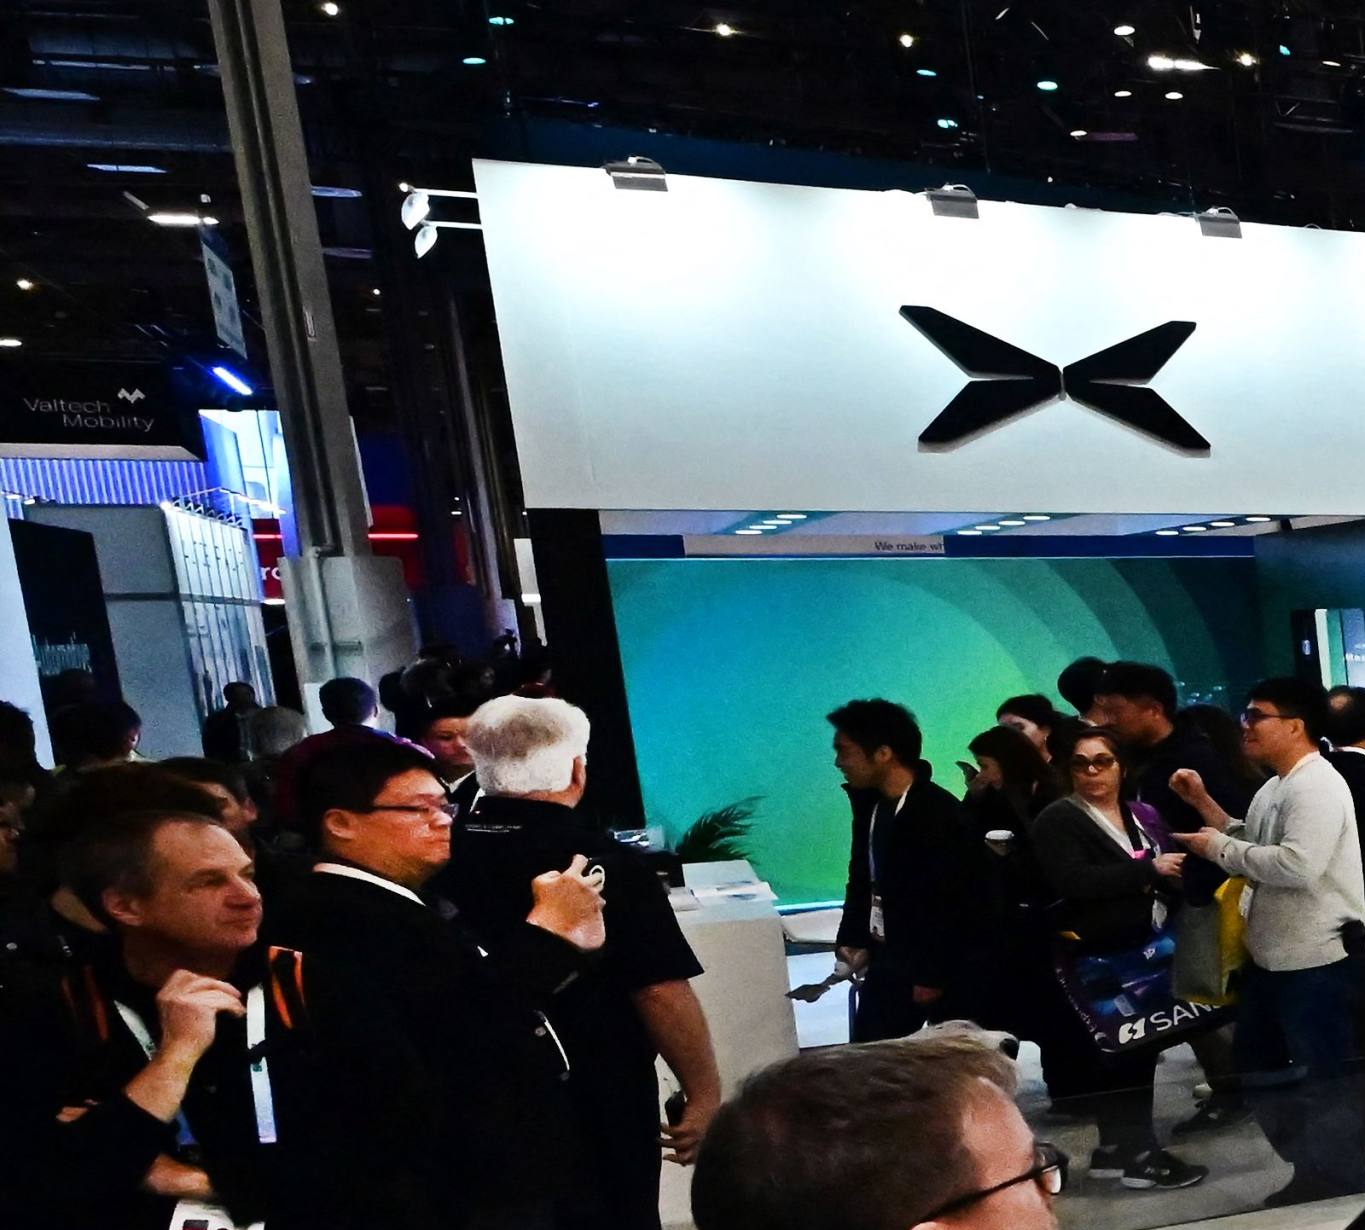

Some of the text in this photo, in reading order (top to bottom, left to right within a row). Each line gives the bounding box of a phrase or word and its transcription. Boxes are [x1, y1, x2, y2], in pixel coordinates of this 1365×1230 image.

[24, 398, 111, 413] Valtech
[63, 414, 155, 432] Mobility
[896, 541, 926, 551] make
